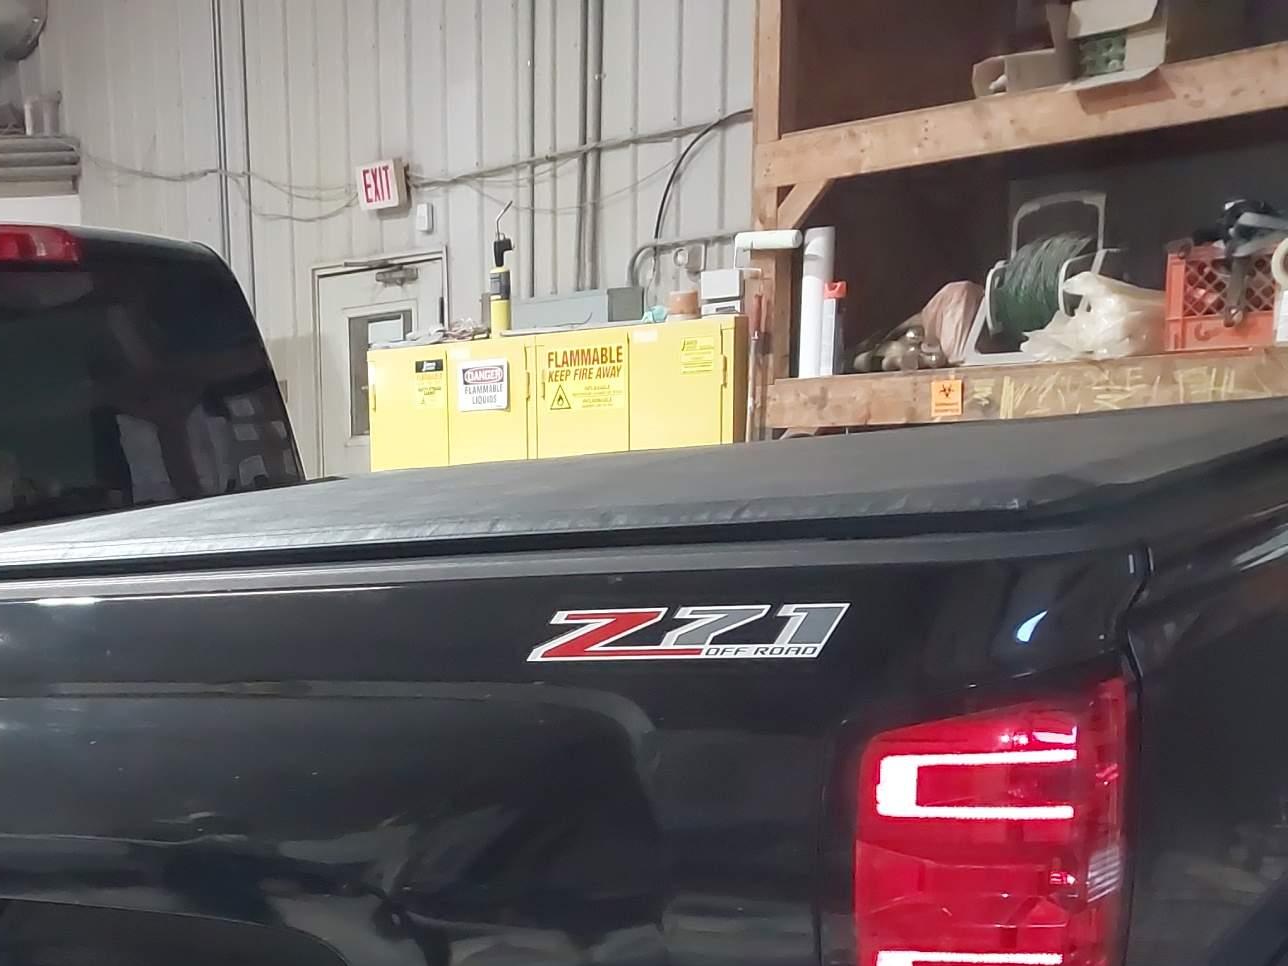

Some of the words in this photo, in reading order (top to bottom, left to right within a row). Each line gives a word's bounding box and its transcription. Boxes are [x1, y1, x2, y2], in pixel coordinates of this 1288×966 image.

[362, 165, 391, 203] EXIT
[547, 345, 623, 368] FLAMMABLE
[466, 367, 502, 381] DANGER
[547, 368, 571, 382] KEEP
[573, 367, 593, 381] FIRE
[595, 365, 622, 379] AWAY
[464, 383, 503, 395] FLAMMABLE
[472, 395, 497, 405] LIQUIDS
[526, 602, 851, 662] Z71
[704, 646, 748, 656] OFF
[750, 645, 818, 656] ROAD
